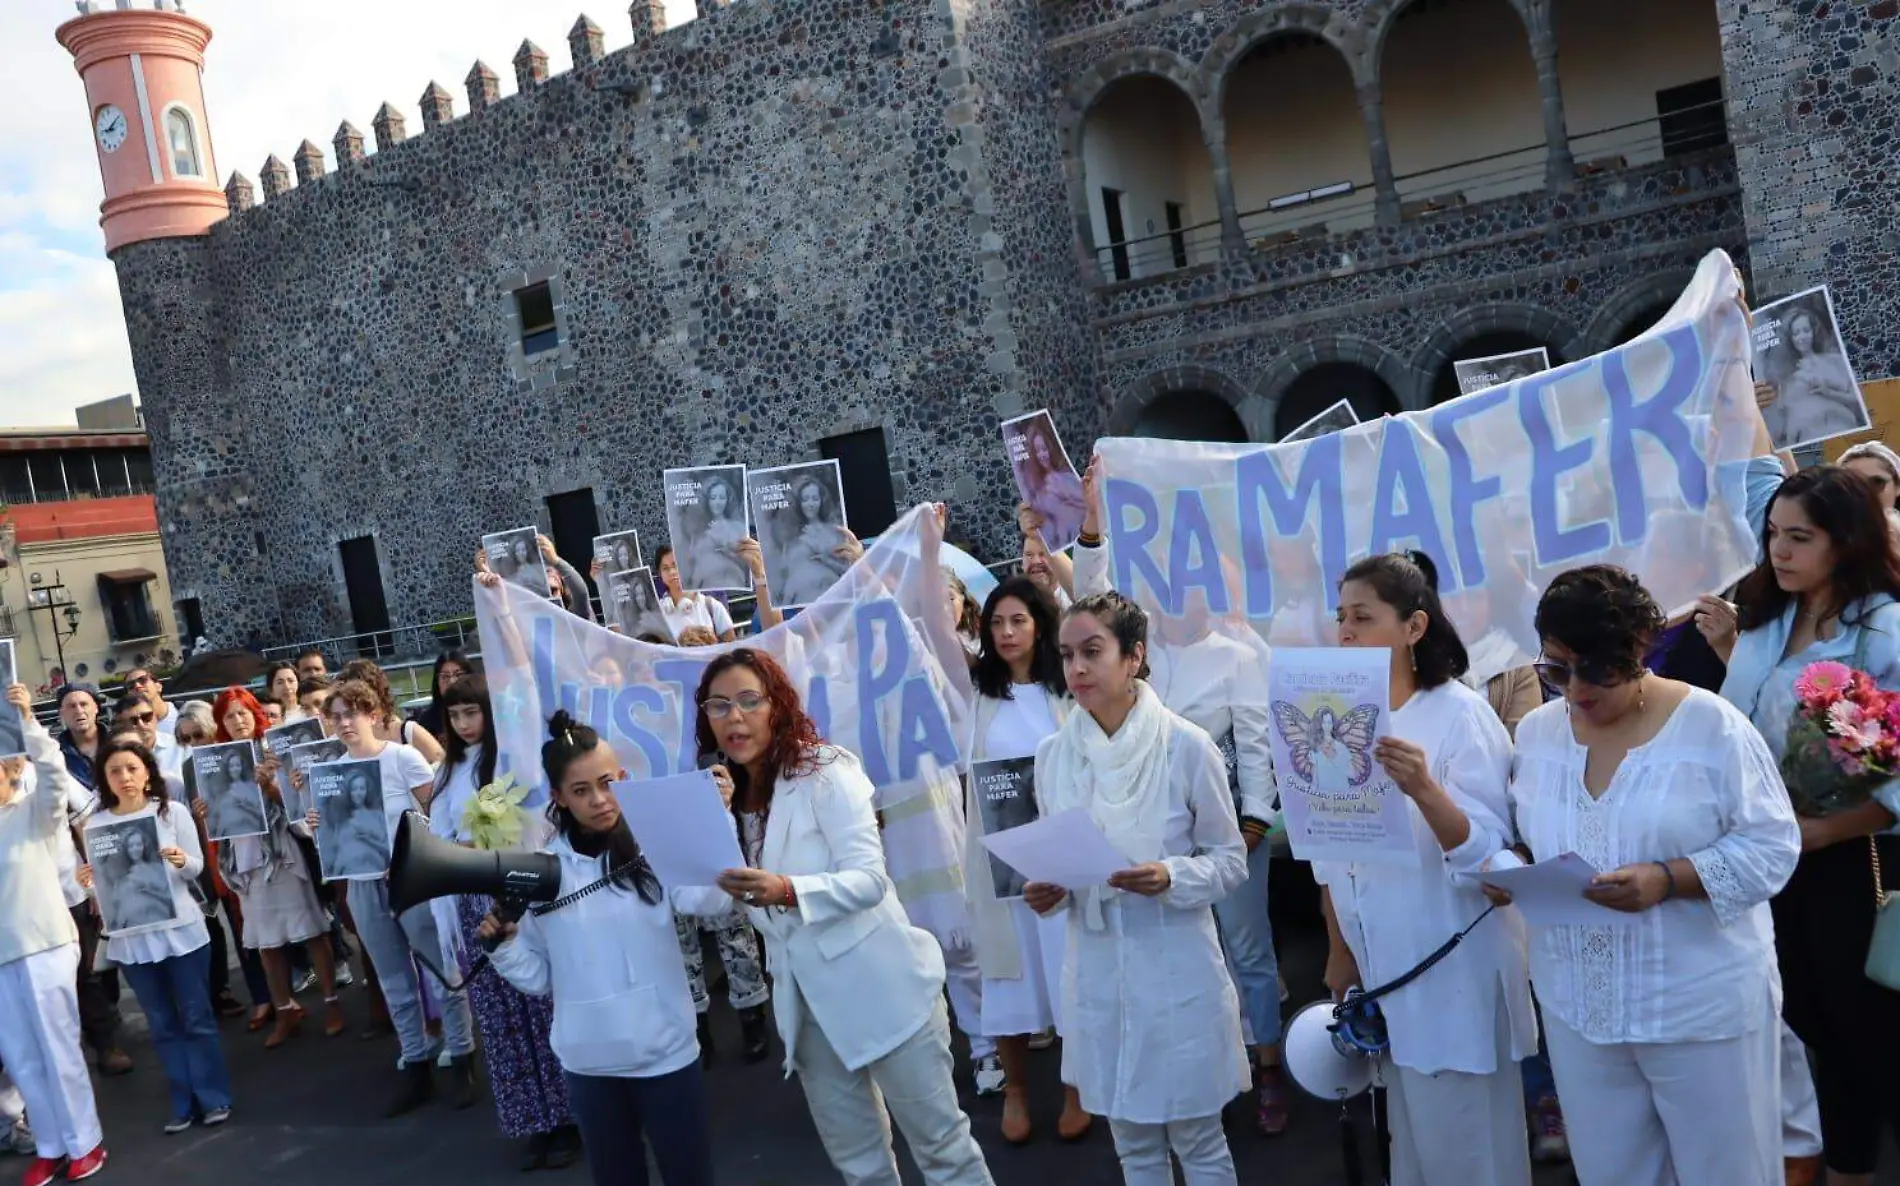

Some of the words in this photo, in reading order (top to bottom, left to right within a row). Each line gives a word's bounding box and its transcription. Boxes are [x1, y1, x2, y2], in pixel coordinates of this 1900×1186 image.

[668, 482, 702, 491] JUSTICIA
[754, 483, 792, 495] JUSTICIA
[676, 490, 696, 499] PARA
[763, 492, 785, 502] PARA
[673, 497, 699, 507] MAFER
[760, 500, 789, 511] MAFER
[980, 771, 1021, 785] JUSTICIA
[989, 782, 1014, 793] PARA
[986, 790, 1018, 801] MAFER
